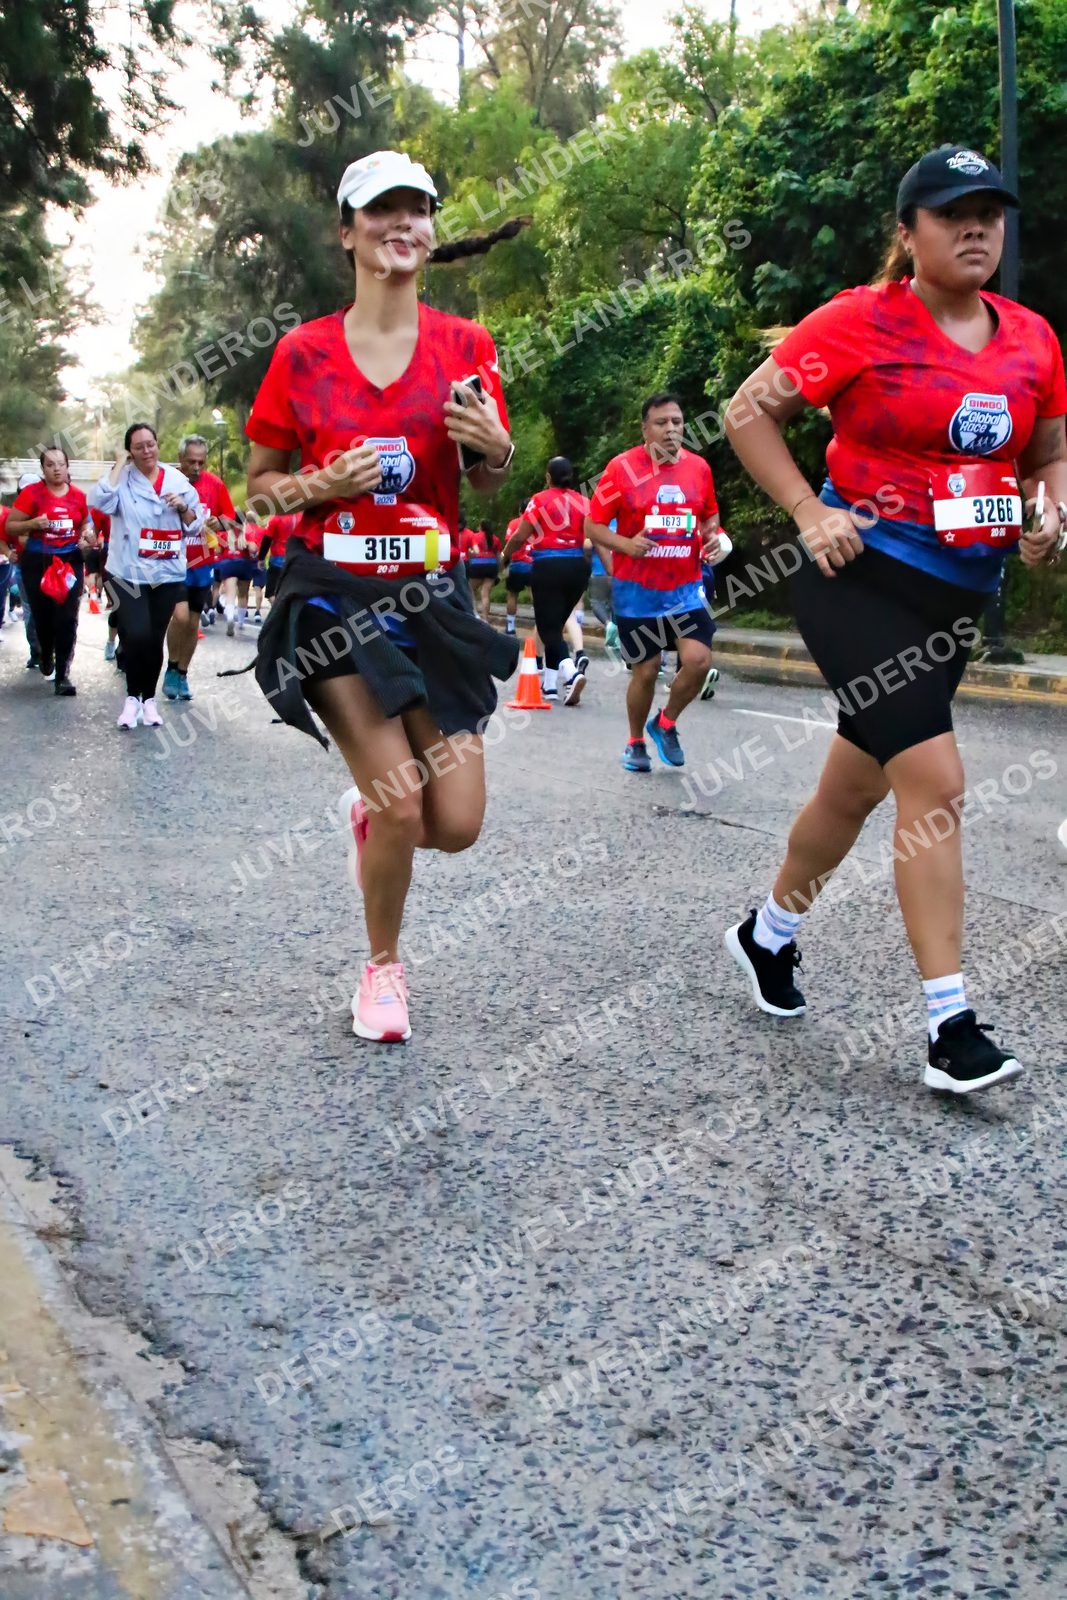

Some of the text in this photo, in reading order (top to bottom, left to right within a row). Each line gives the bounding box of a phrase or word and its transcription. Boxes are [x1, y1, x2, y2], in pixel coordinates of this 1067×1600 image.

[969, 400, 1002, 409] BIMBO
[968, 411, 1001, 425] Global
[960, 421, 988, 433] Race
[380, 455, 402, 467] obal
[973, 498, 1013, 523] 3266
[662, 516, 681, 526] 1673
[365, 537, 410, 560] 3151
